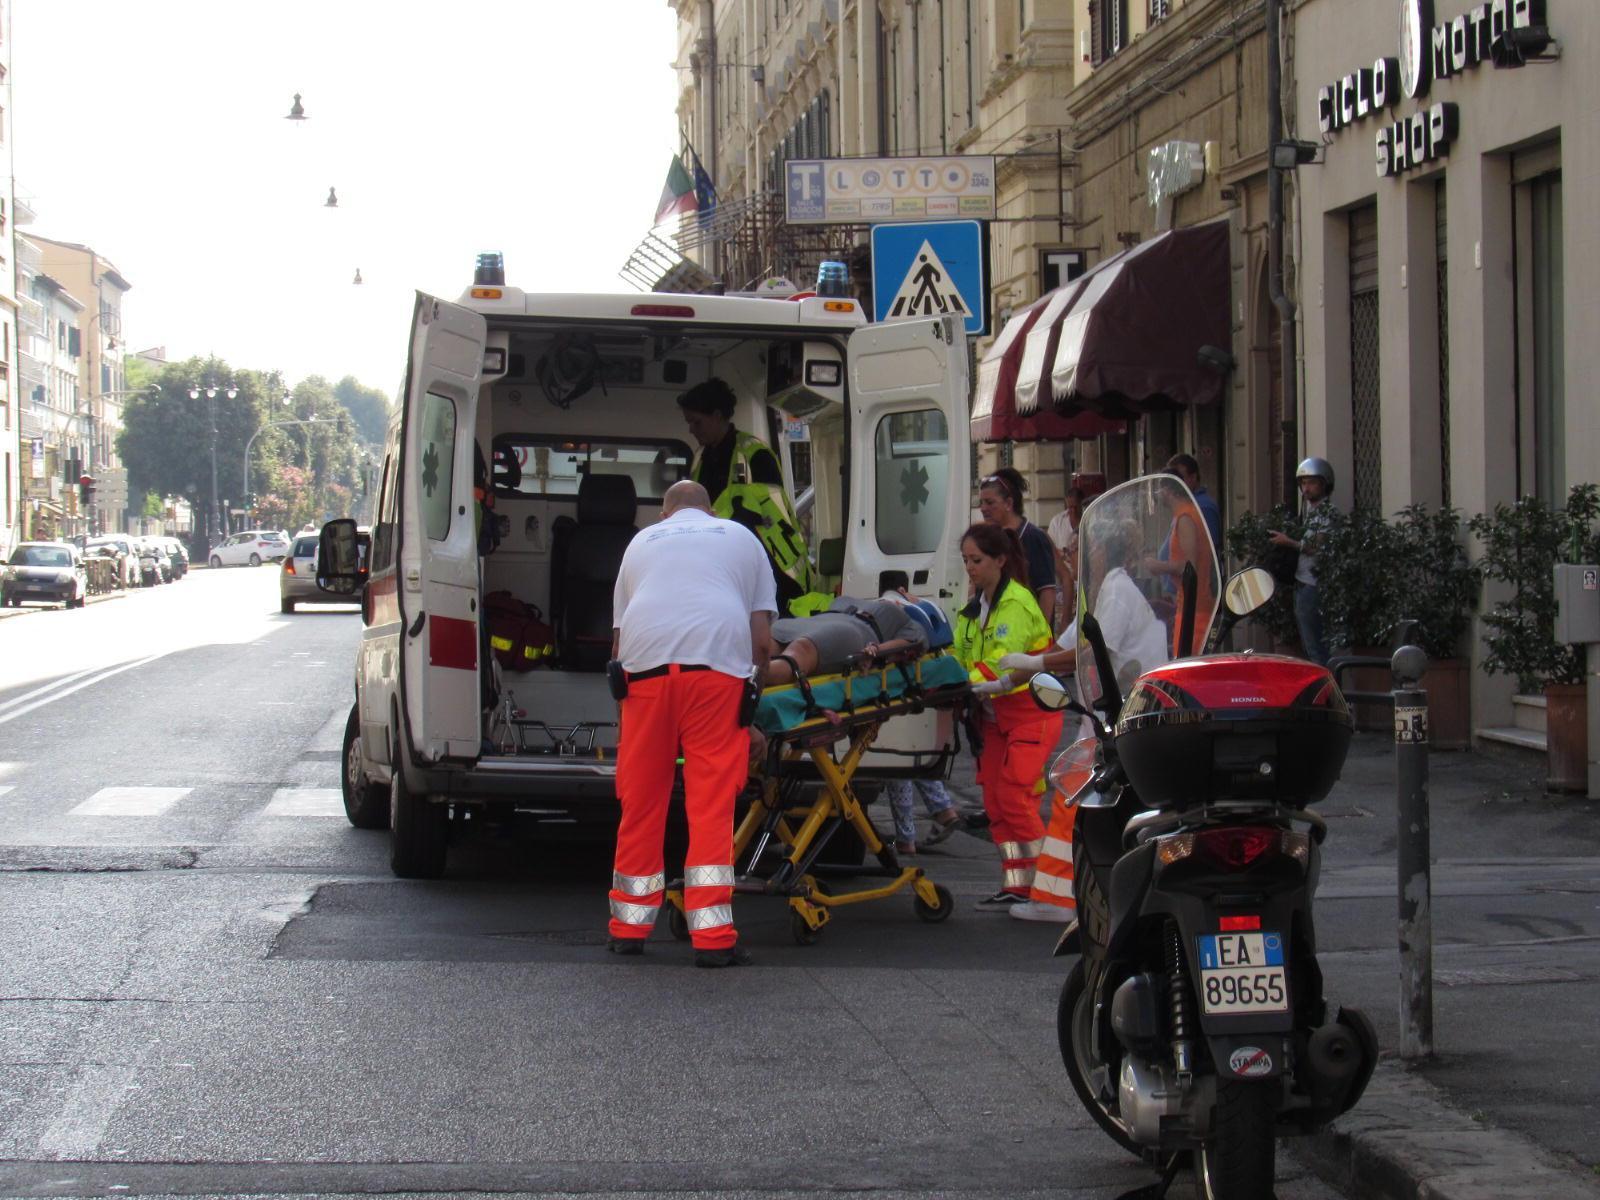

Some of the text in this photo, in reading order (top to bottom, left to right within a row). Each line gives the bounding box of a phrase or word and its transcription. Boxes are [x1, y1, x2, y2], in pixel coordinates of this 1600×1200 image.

[1318, 57, 1388, 133] CICLO
[1375, 102, 1446, 177] SHOP
[791, 165, 820, 200] T
[1047, 253, 1079, 289] T
[1219, 935, 1252, 966] EA
[1206, 973, 1284, 1006] 89655
